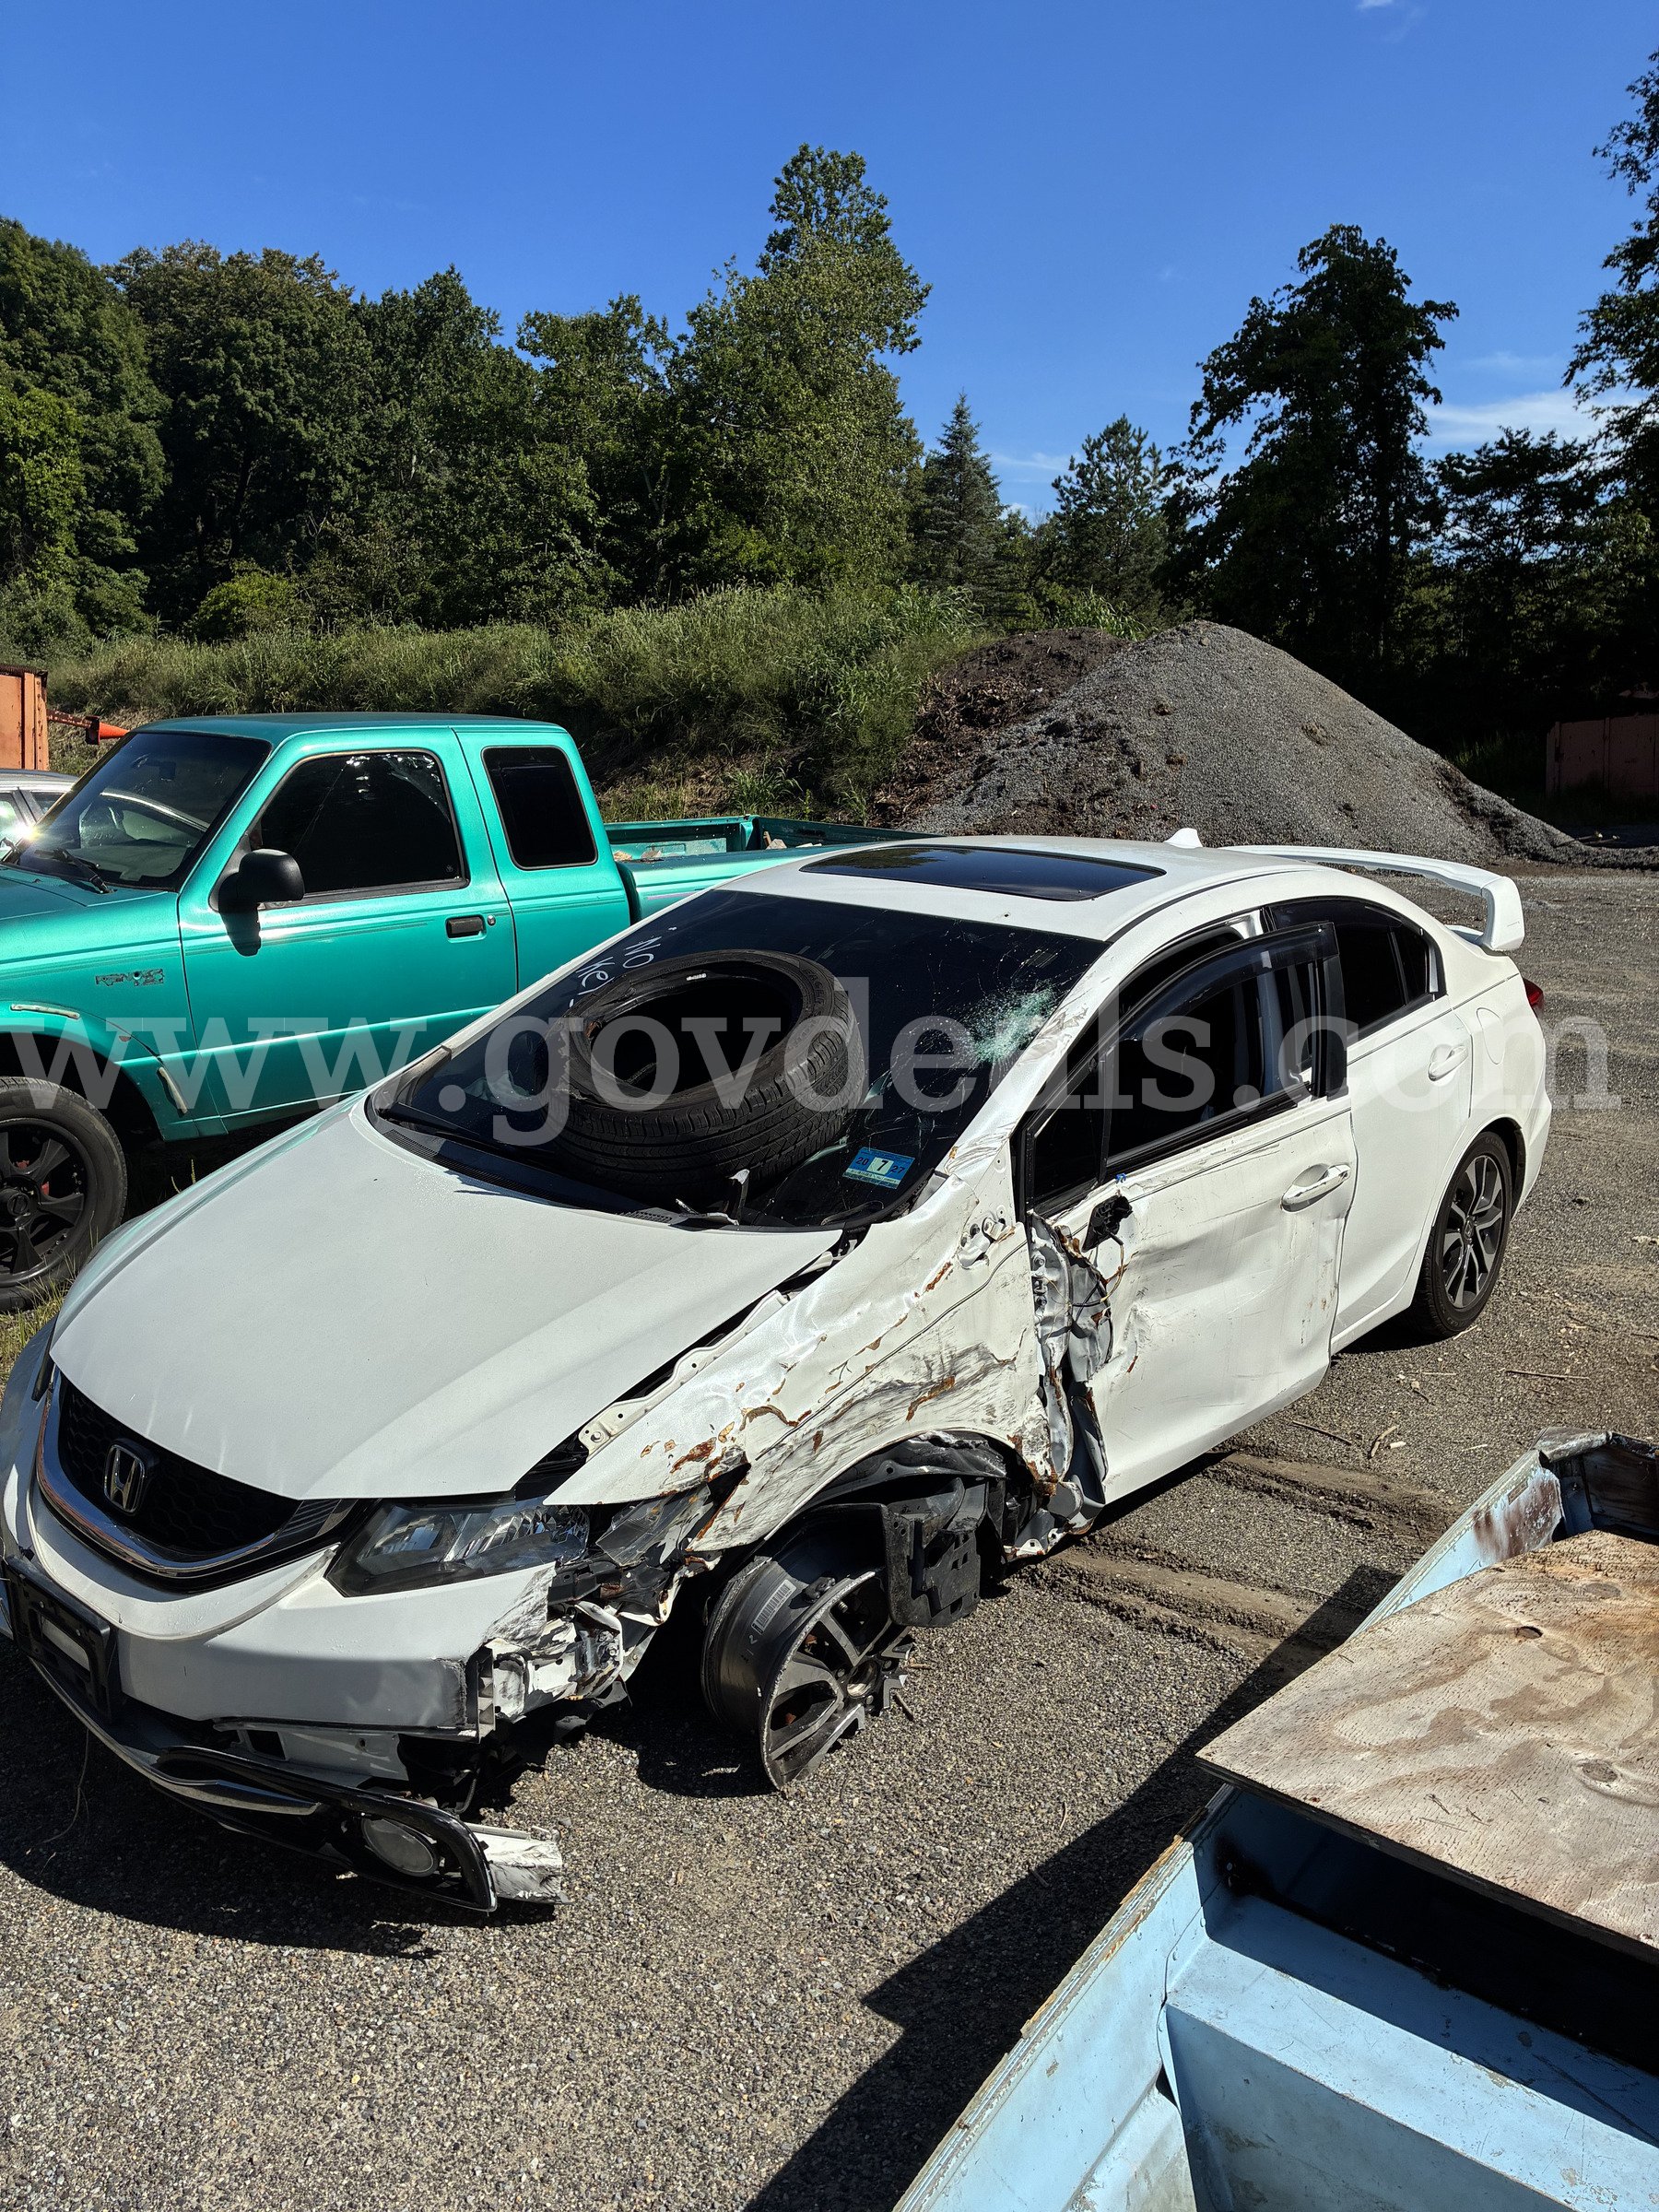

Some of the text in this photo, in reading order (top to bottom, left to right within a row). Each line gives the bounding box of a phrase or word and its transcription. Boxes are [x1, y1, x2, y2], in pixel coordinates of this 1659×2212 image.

[855, 1157, 906, 1174] 20 7 27
